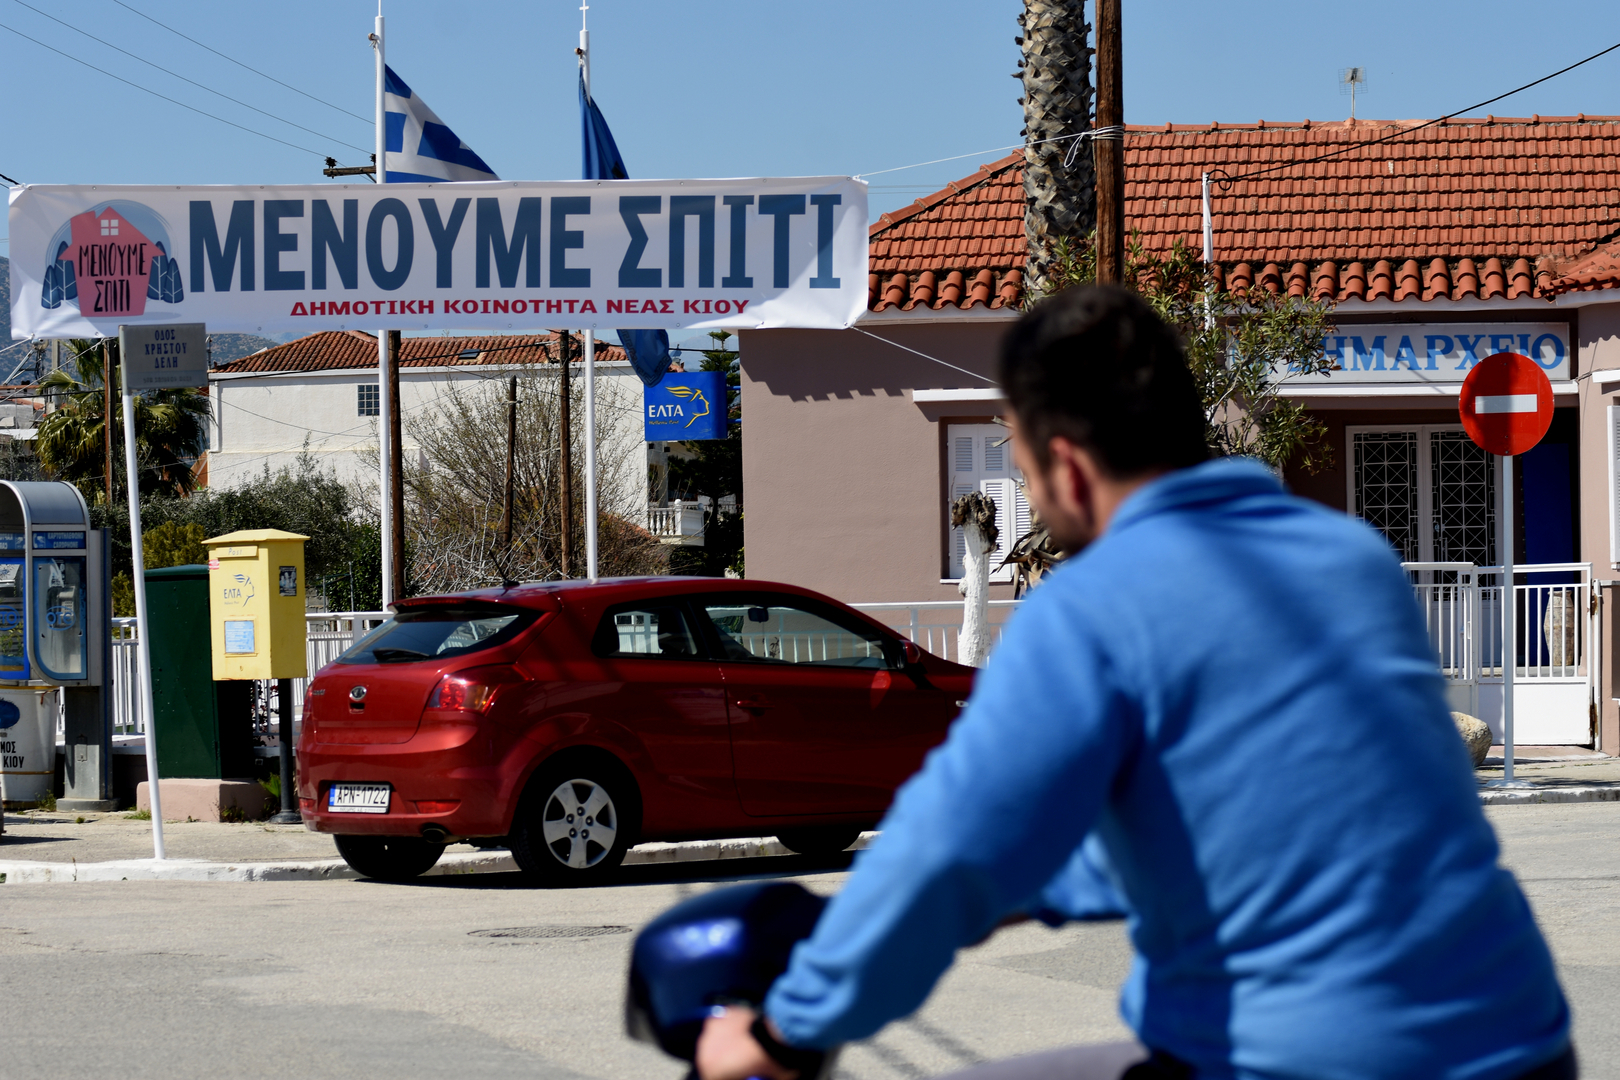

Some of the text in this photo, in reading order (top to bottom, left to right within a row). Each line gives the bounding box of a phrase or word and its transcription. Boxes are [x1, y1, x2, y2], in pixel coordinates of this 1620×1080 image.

[189, 194, 842, 293] ΜΕΝΟΥΜΕ ΣΠΙΤΙ
[79, 242, 148, 278] ΜΕΝΟΥΜΕ
[93, 279, 131, 312] ΣΠΙΤΙ
[290, 299, 751, 317] ΔΗΜΟΤΙΚΗ ΚΟΙΝΟΤΗΤΑ ΝΕΑΣ ΚΙΟΥ
[154, 329, 176, 341] ΟΔΟΣ
[144, 342, 187, 355] ΧΡΗΣΤΟΥ
[1287, 332, 1565, 372] ΗΜΑΡΧΕΙΟ
[154, 356, 178, 369] ΔΕΛΗ
[648, 404, 684, 418] ΕΛΤΑ
[223, 588, 242, 599] ΕΛΤΑ
[3, 755, 25, 769] ΚΙΟΥ
